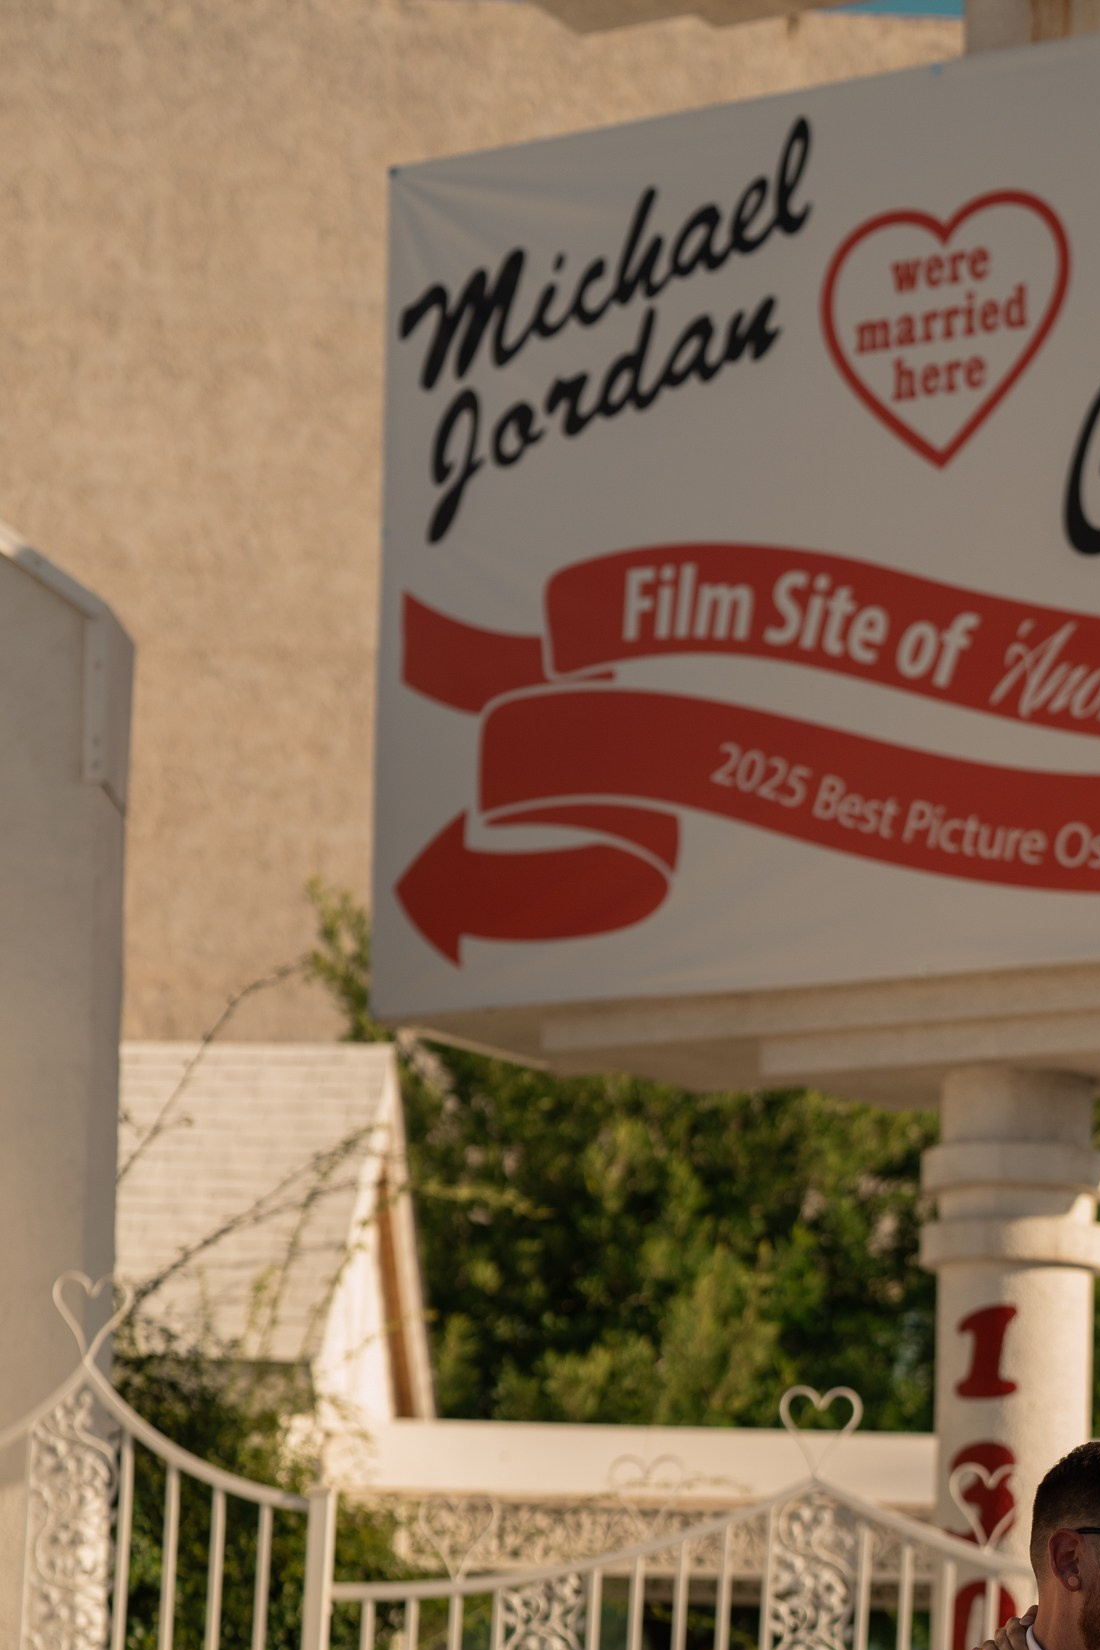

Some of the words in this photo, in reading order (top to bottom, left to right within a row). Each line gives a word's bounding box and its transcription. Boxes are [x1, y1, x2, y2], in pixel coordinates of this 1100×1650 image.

[400, 115, 812, 391] Michael
[890, 247, 991, 294] were
[855, 283, 1029, 355] married
[891, 356, 988, 403] here
[426, 296, 781, 546] Jordan
[621, 562, 754, 643] Film
[763, 570, 889, 664] Site
[896, 611, 981, 689] of
[710, 741, 811, 807] 2025
[812, 774, 900, 839] Best
[902, 800, 1047, 865] Picture
